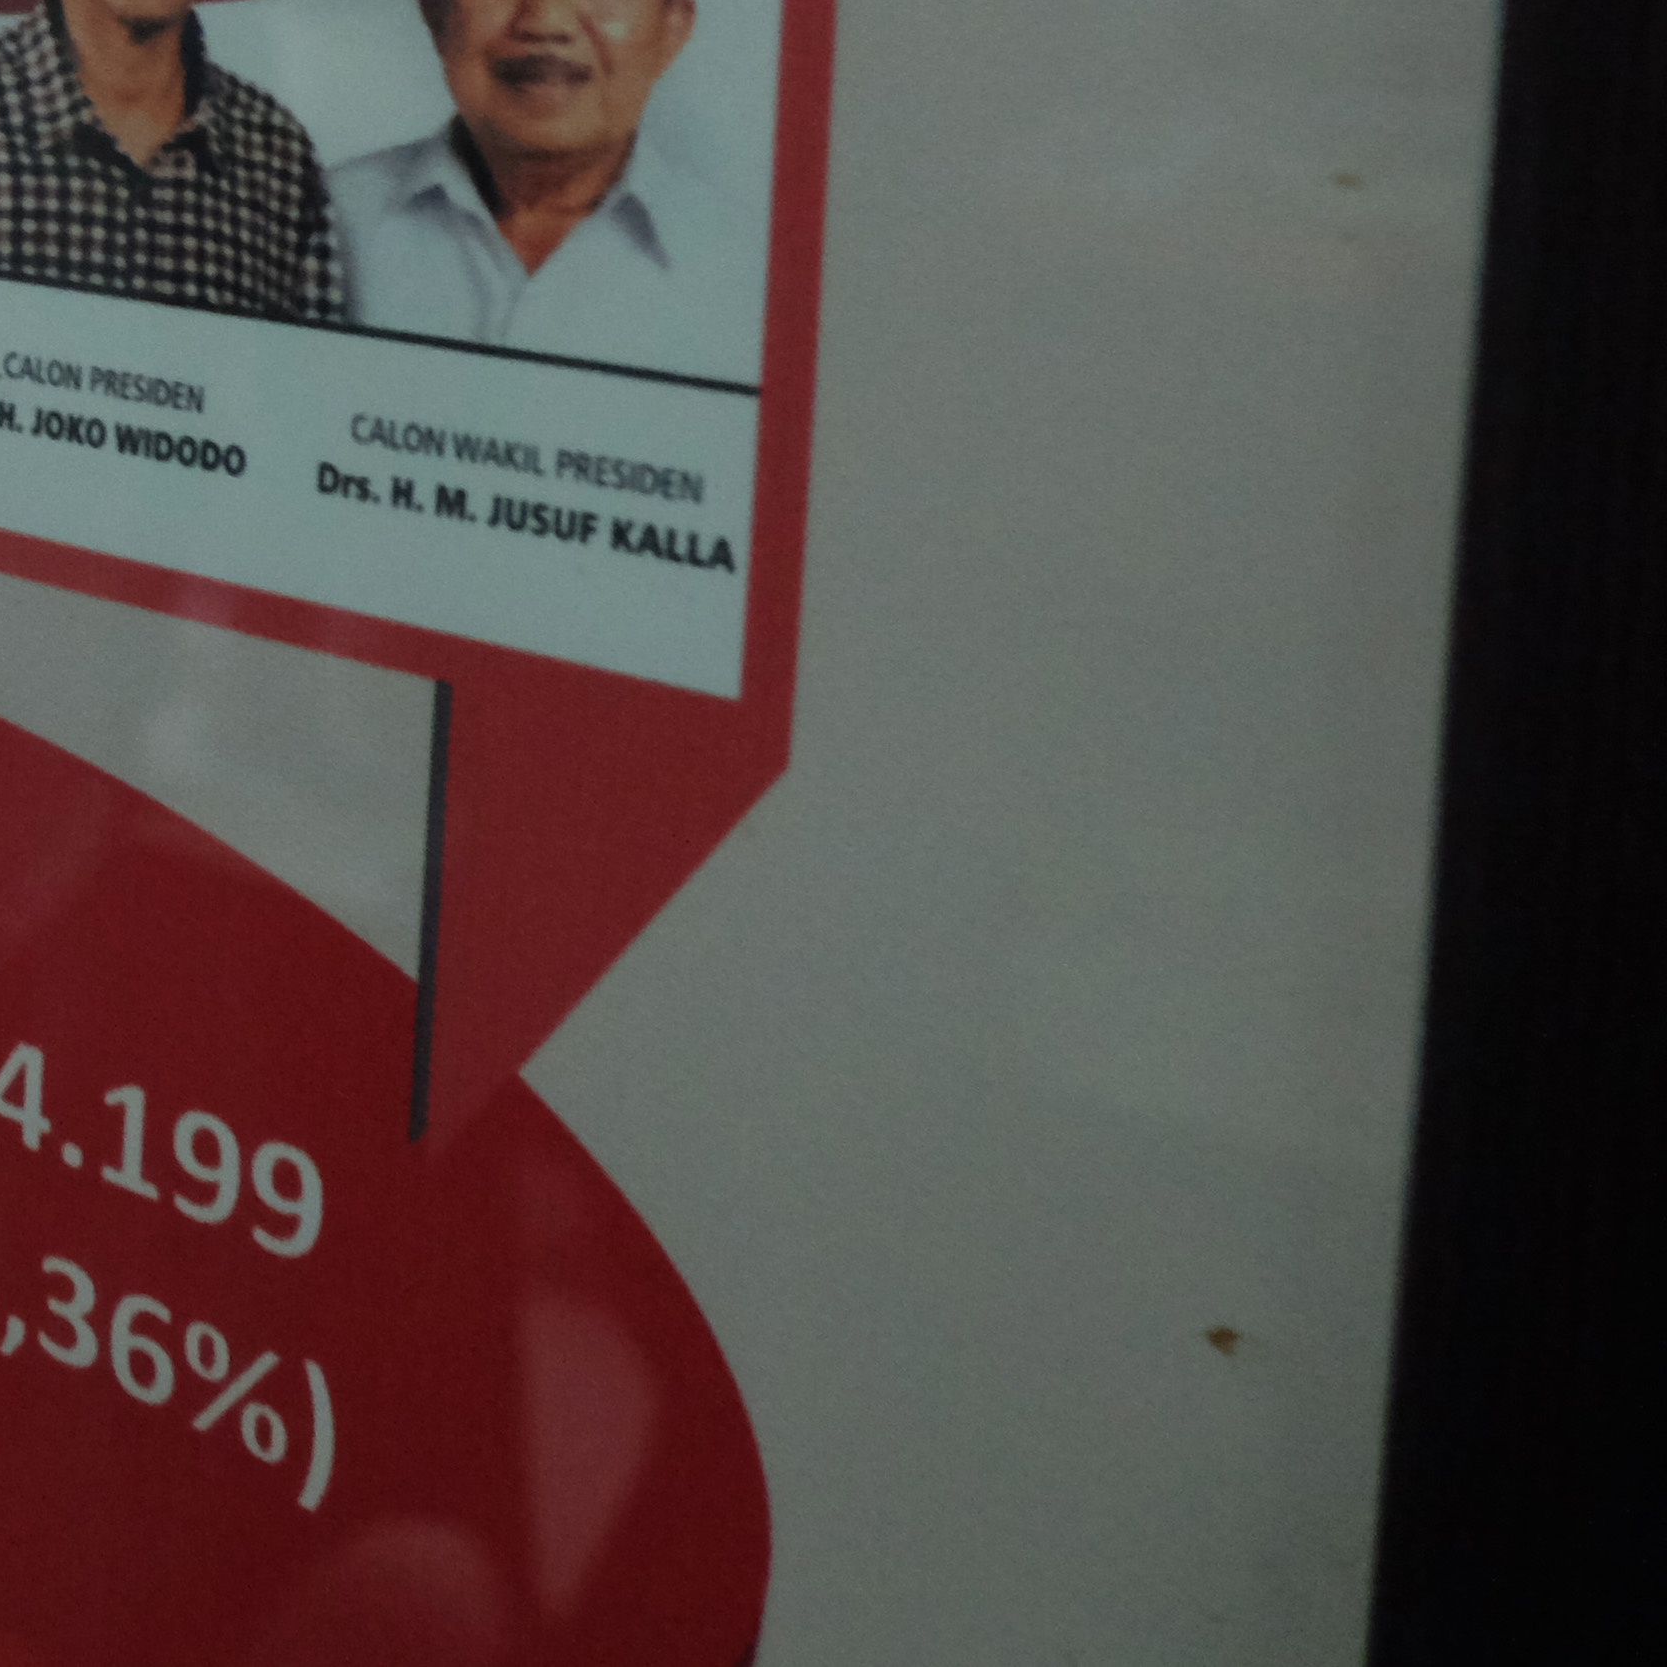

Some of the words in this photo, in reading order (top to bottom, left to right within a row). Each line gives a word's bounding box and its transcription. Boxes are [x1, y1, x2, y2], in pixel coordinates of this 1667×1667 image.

[89, 365, 205, 414] PRESIDEN
[31, 406, 107, 449] JOKO
[114, 421, 247, 478] WIDODO
[350, 412, 447, 458] CALON
[451, 430, 546, 478] WAKIL
[555, 447, 704, 504] PRESIDEN
[317, 461, 381, 505] Drs.
[391, 475, 425, 514] H.
[434, 484, 478, 523] M.
[487, 495, 600, 544] JUSUF
[610, 516, 737, 574] KALLA
